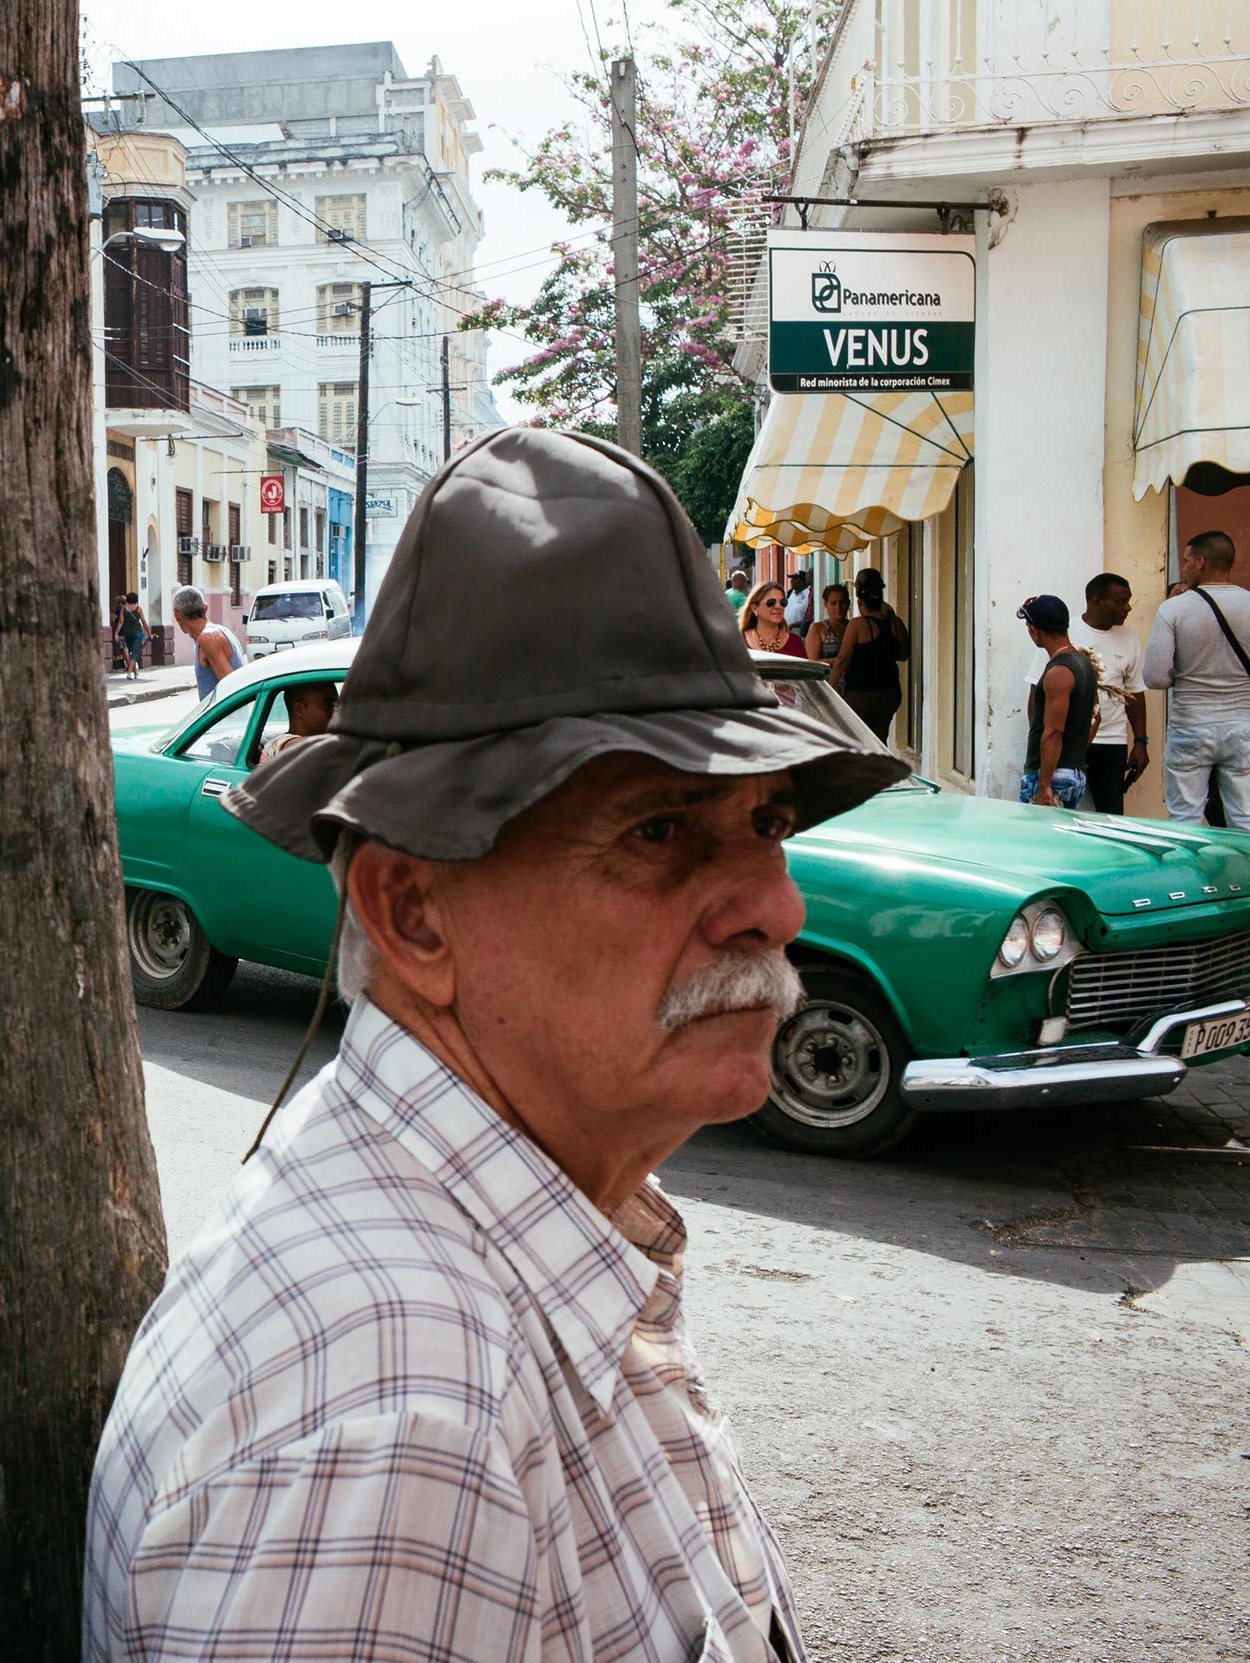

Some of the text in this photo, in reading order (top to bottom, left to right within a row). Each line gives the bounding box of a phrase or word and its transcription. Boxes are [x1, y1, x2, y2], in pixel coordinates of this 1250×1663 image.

[843, 288, 941, 306] Panamericana
[823, 328, 929, 366] VENUS
[800, 376, 951, 388] Red minorista de la corporación Cimex
